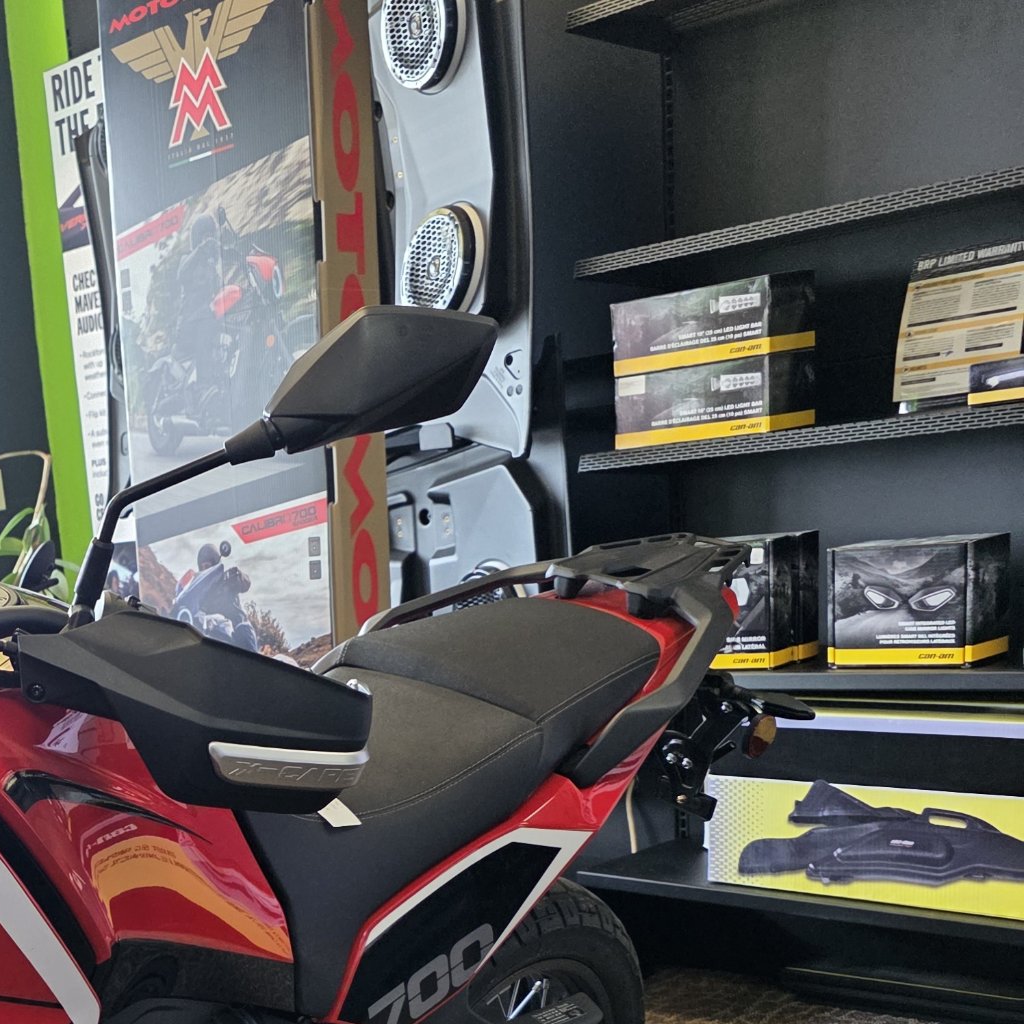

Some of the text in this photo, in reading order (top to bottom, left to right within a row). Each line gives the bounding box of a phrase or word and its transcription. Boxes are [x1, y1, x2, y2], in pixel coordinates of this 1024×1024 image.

[51, 59, 95, 112] RIDE
[917, 259, 937, 271] BRP
[937, 250, 975, 268] LIMITED
[729, 343, 762, 354] can-am
[729, 422, 762, 432] can-am
